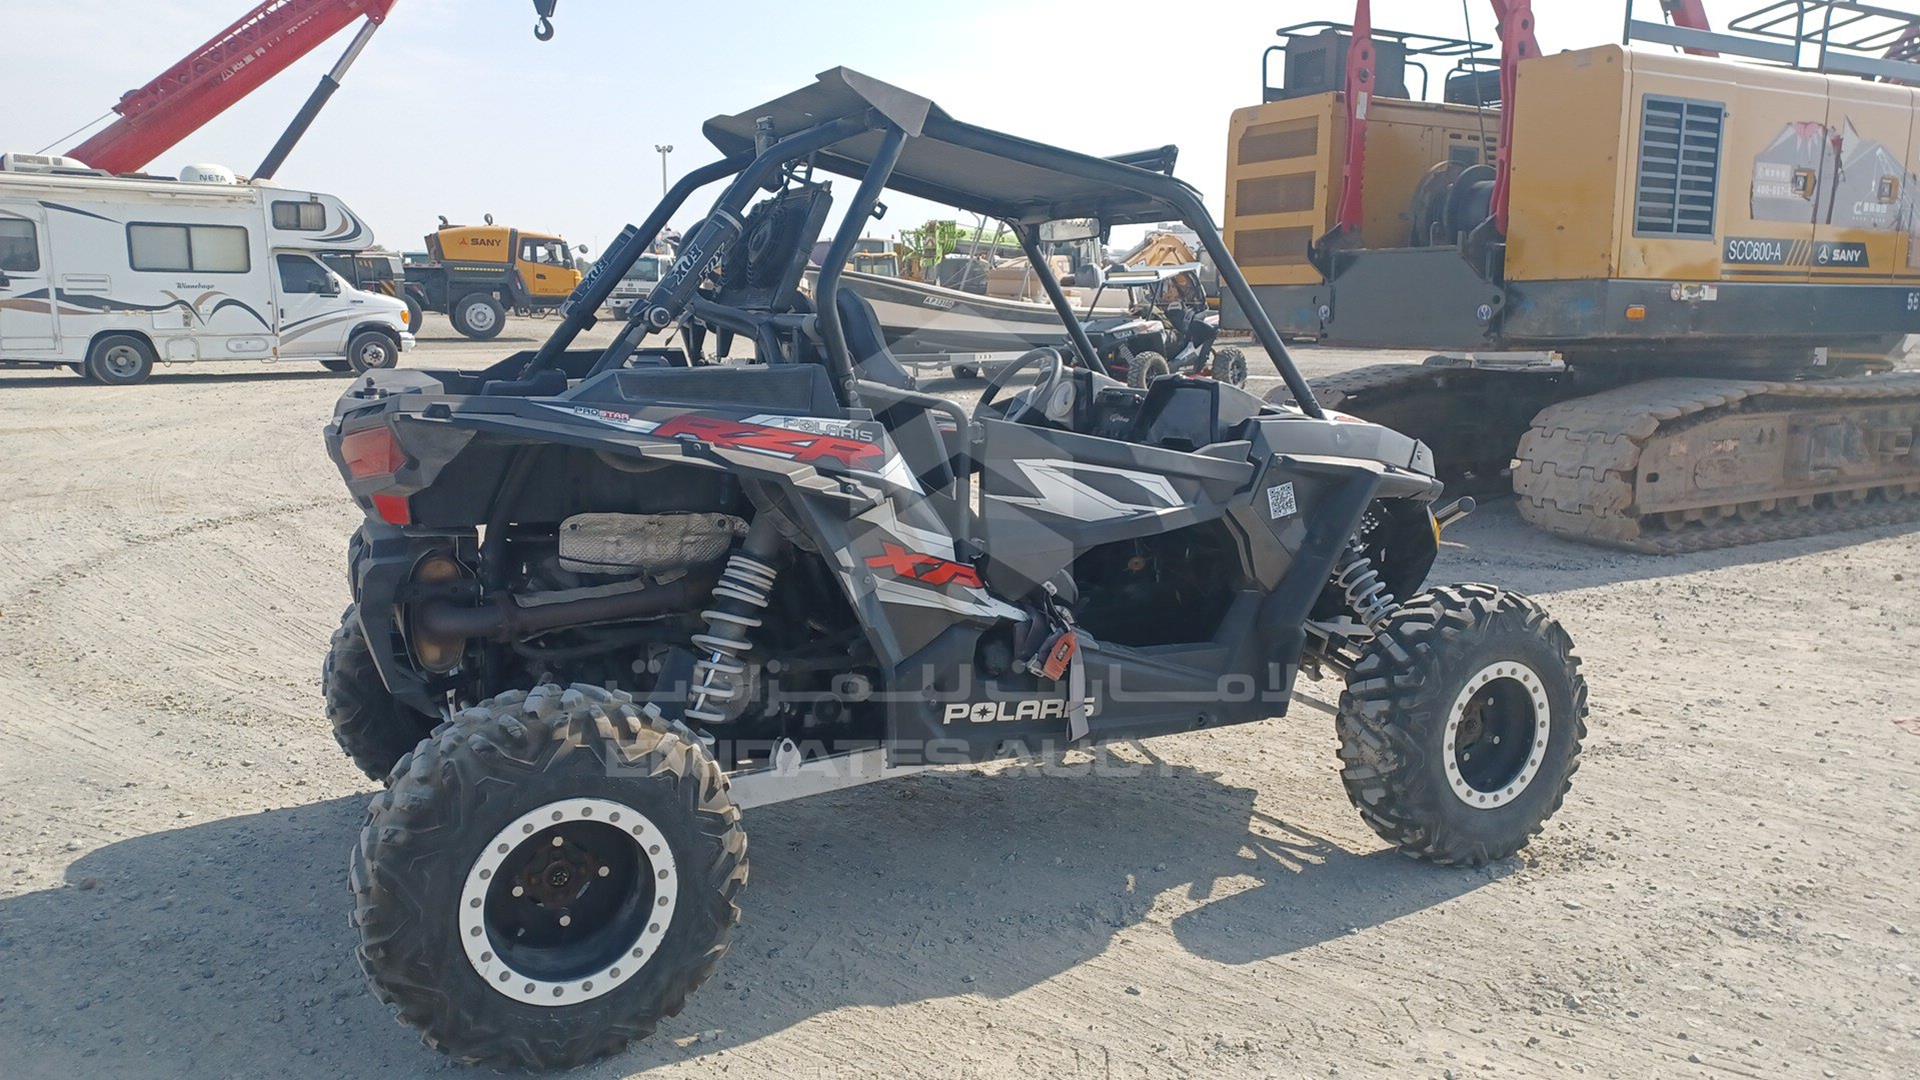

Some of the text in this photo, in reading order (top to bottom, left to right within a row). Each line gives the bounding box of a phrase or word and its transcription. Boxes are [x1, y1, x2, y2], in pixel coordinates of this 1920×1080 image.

[199, 174, 226, 183] NETA
[470, 237, 502, 247] SANY
[1728, 240, 1782, 261] SCC600-A
[668, 244, 704, 285] FOX
[1832, 248, 1862, 262] SANY
[783, 417, 873, 442] POLARIS
[655, 414, 884, 470] RZR
[943, 697, 1096, 725] POLARIS
